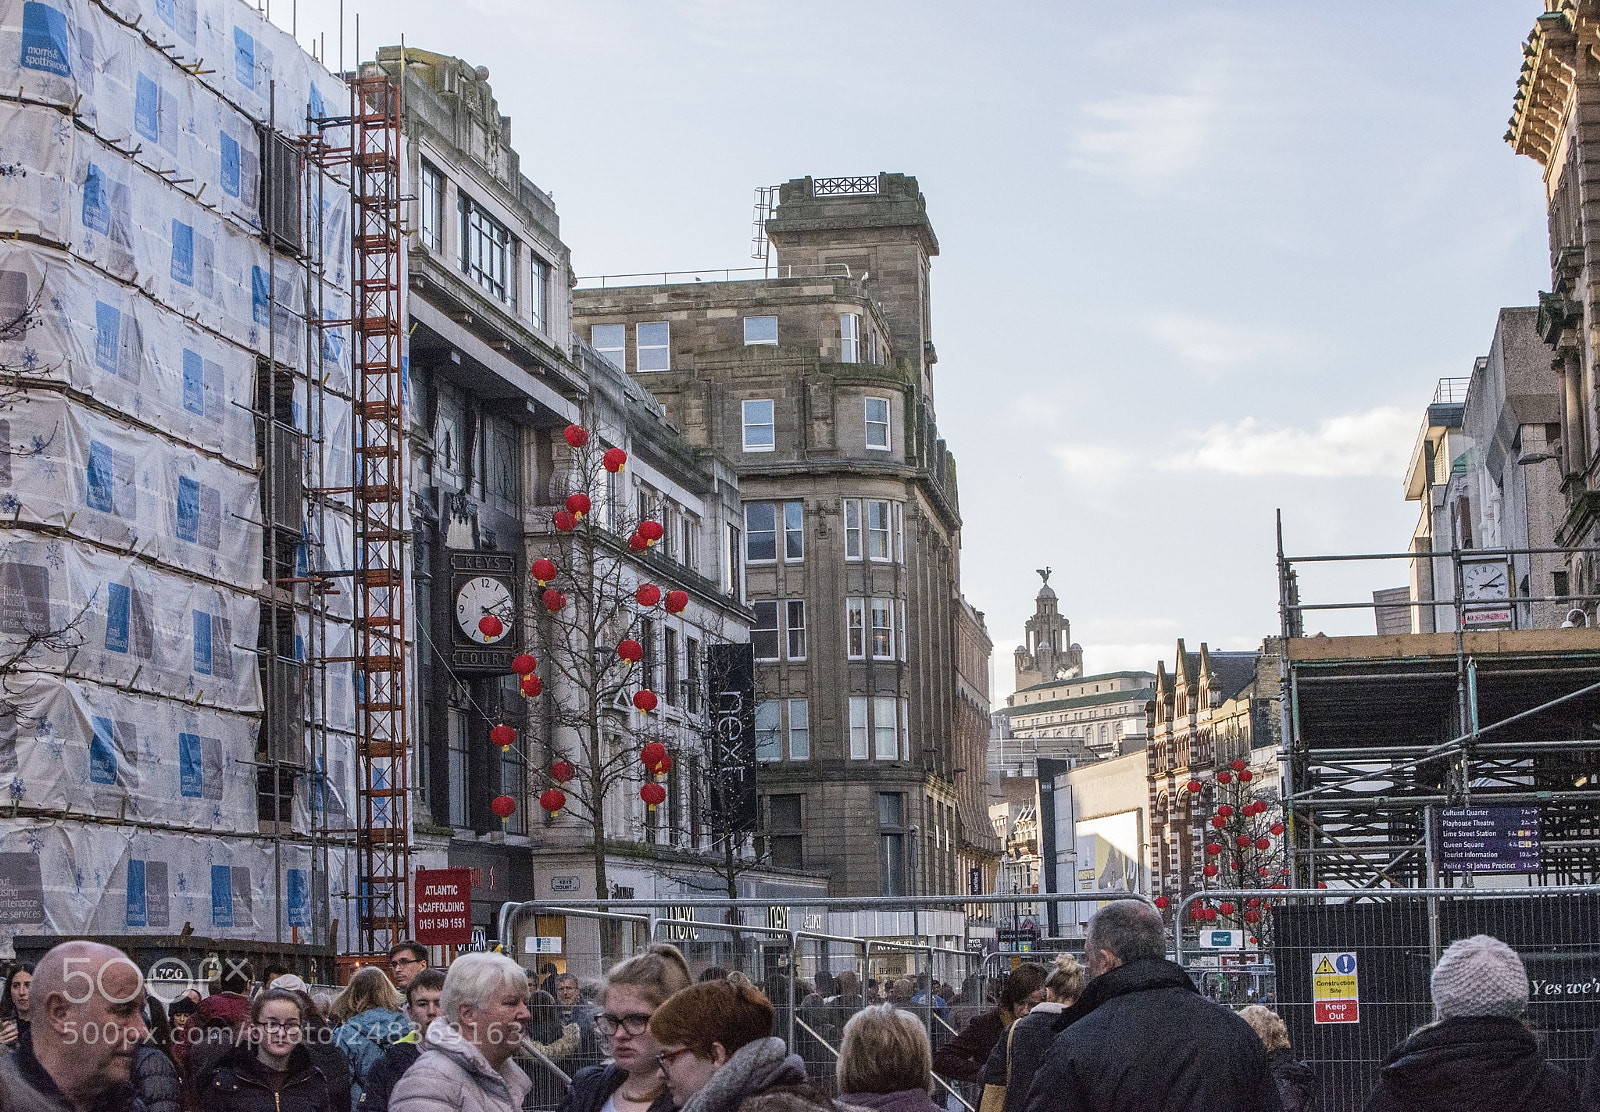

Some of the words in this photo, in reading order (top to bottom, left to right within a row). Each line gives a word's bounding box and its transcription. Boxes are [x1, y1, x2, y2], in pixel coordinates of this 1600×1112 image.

[465, 556, 501, 569] KEYS
[481, 578, 490, 588] 12
[458, 604, 465, 614] 9
[461, 652, 509, 664] COURT
[718, 692, 745, 781] next
[1466, 809, 1489, 817] Quarter
[1442, 820, 1472, 828] Playhouse
[1473, 862, 1490, 871] Johns
[425, 885, 458, 896] ATLANTIC
[418, 902, 465, 913] SCAFFOLDING
[419, 919, 435, 930] 0151
[436, 919, 449, 929] 549
[450, 918, 466, 929] 1551
[1531, 979, 1562, 996] Yes
[1325, 1003, 1347, 1012] Keep
[1328, 1012, 1345, 1020] Out
